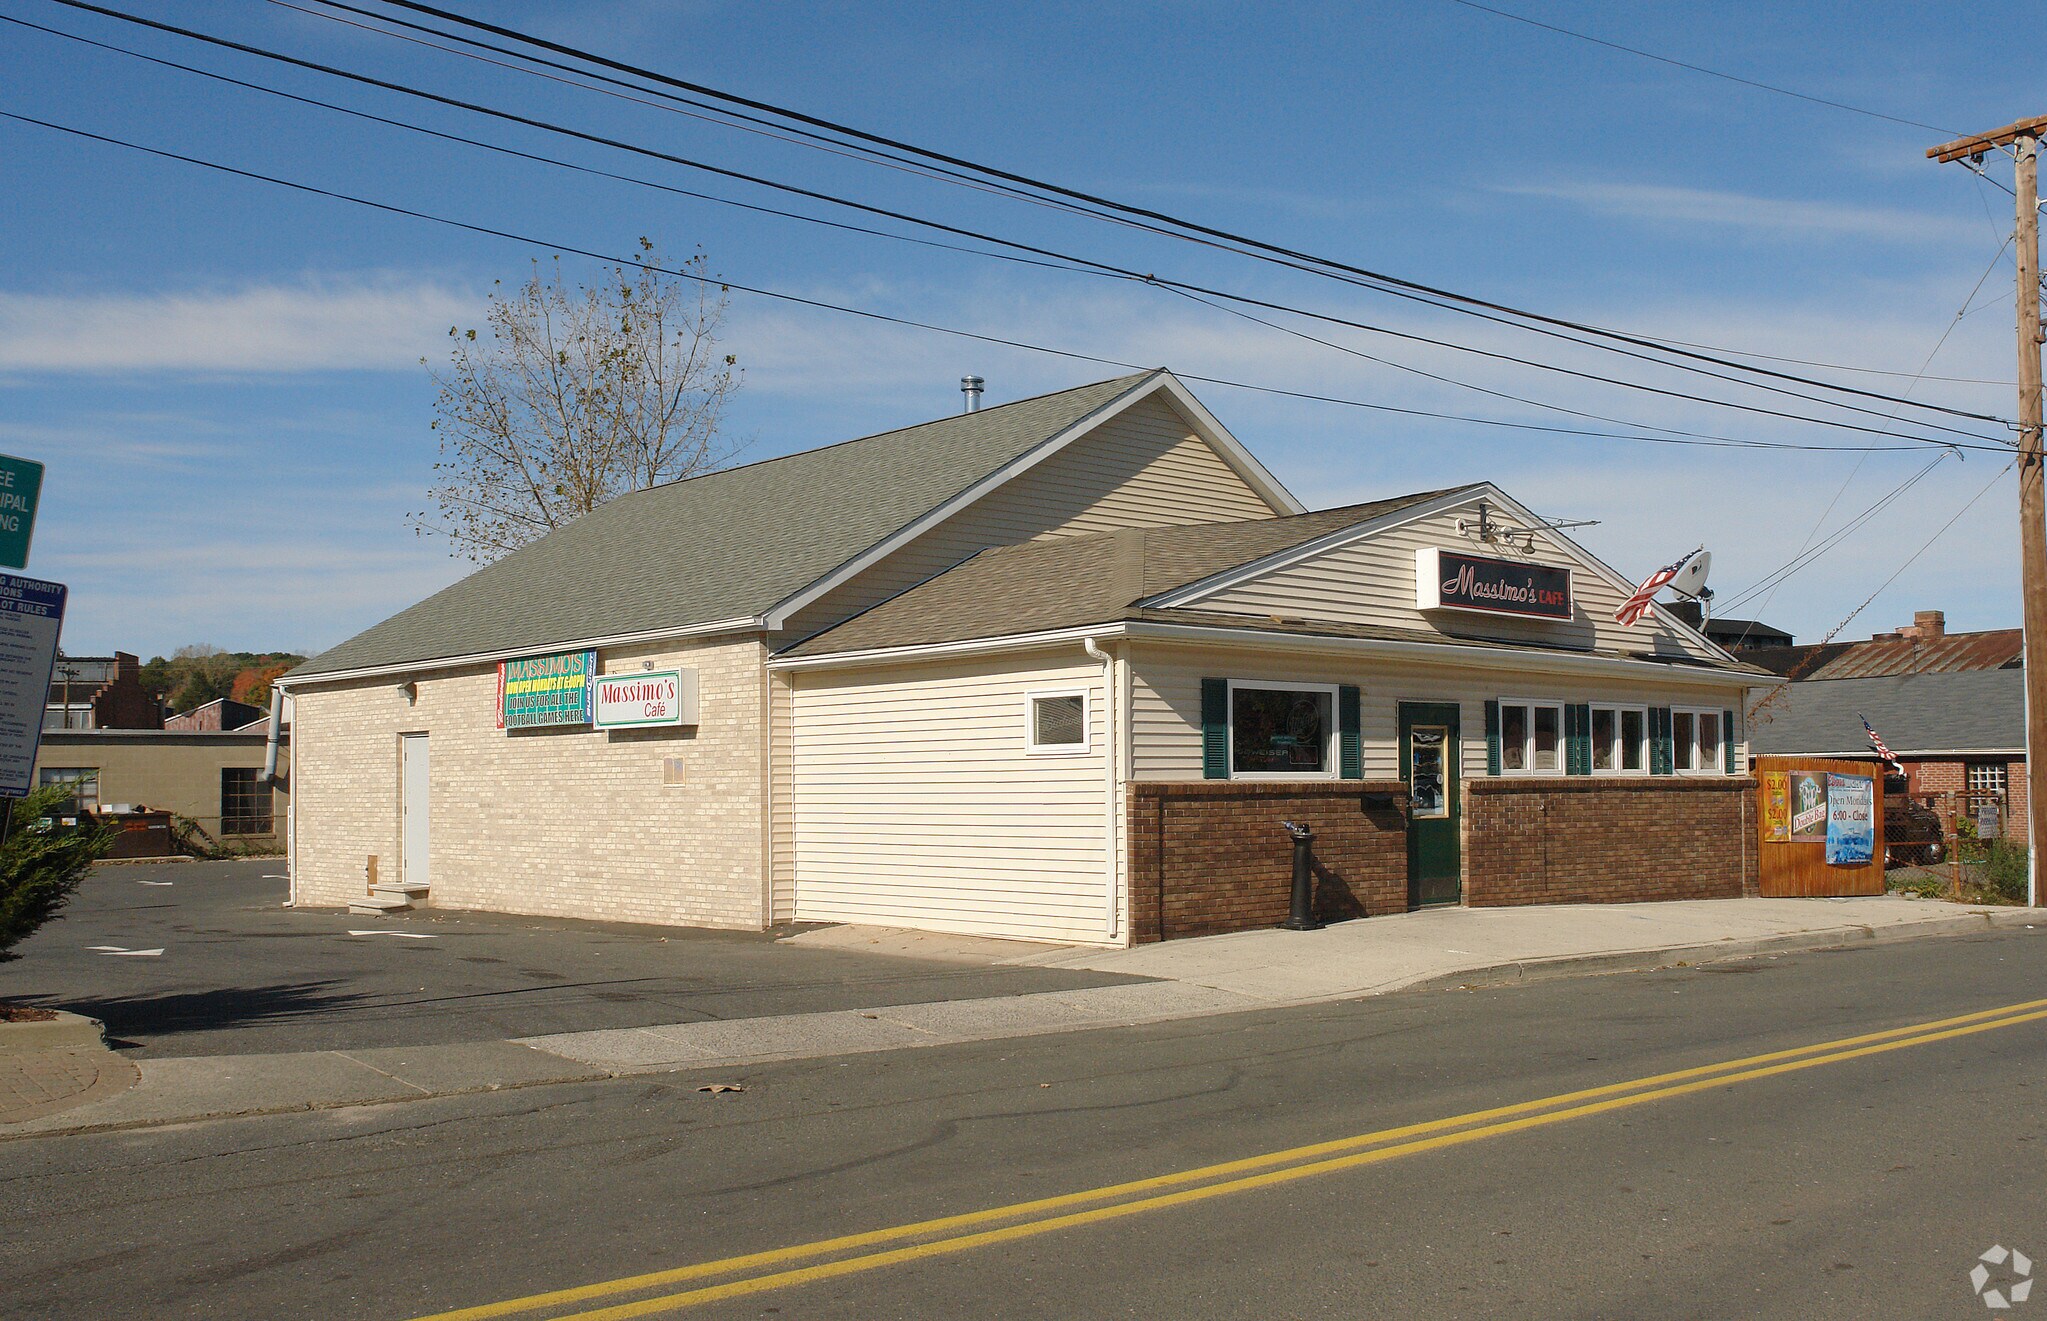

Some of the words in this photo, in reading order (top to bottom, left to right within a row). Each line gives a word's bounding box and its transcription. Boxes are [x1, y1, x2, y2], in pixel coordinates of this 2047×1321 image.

[0, 492, 29, 513] IPAL
[9, 577, 63, 594] AUTHORITY
[1441, 564, 1537, 604] Massimo's
[1538, 589, 1564, 606] CAFE
[0, 599, 14, 610] OT
[17, 603, 48, 615] RULES
[508, 653, 583, 680] MASSIMO'S
[601, 679, 675, 704] Massimo's
[509, 696, 524, 709] JOIN
[525, 696, 535, 708] US
[536, 694, 550, 707] FOR
[550, 693, 563, 705] ALL
[564, 692, 578, 704] THE
[505, 712, 537, 726] FOOTBALL
[564, 709, 584, 722] HERE
[644, 701, 666, 718] Café
[1832, 810, 1847, 821] 6:00
[1852, 810, 1868, 821] Close
